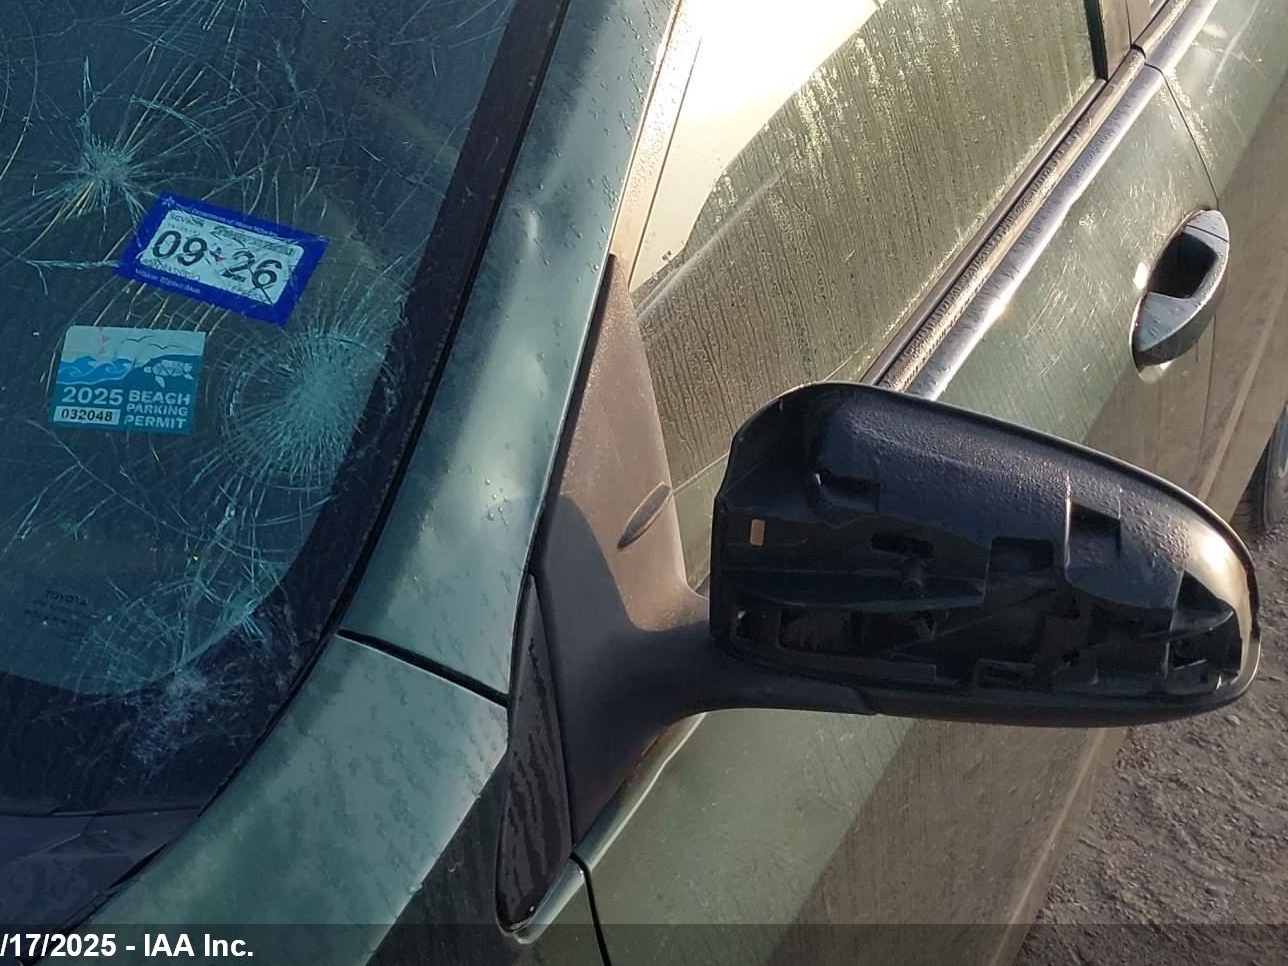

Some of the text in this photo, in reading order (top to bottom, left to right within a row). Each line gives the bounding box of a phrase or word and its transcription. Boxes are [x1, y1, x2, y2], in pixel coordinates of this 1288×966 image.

[152, 230, 208, 266] 09
[220, 250, 282, 290] 26
[61, 386, 191, 406] 2025 BEACH
[61, 408, 187, 430] 032048 PERMIT
[126, 403, 189, 417] PARKING
